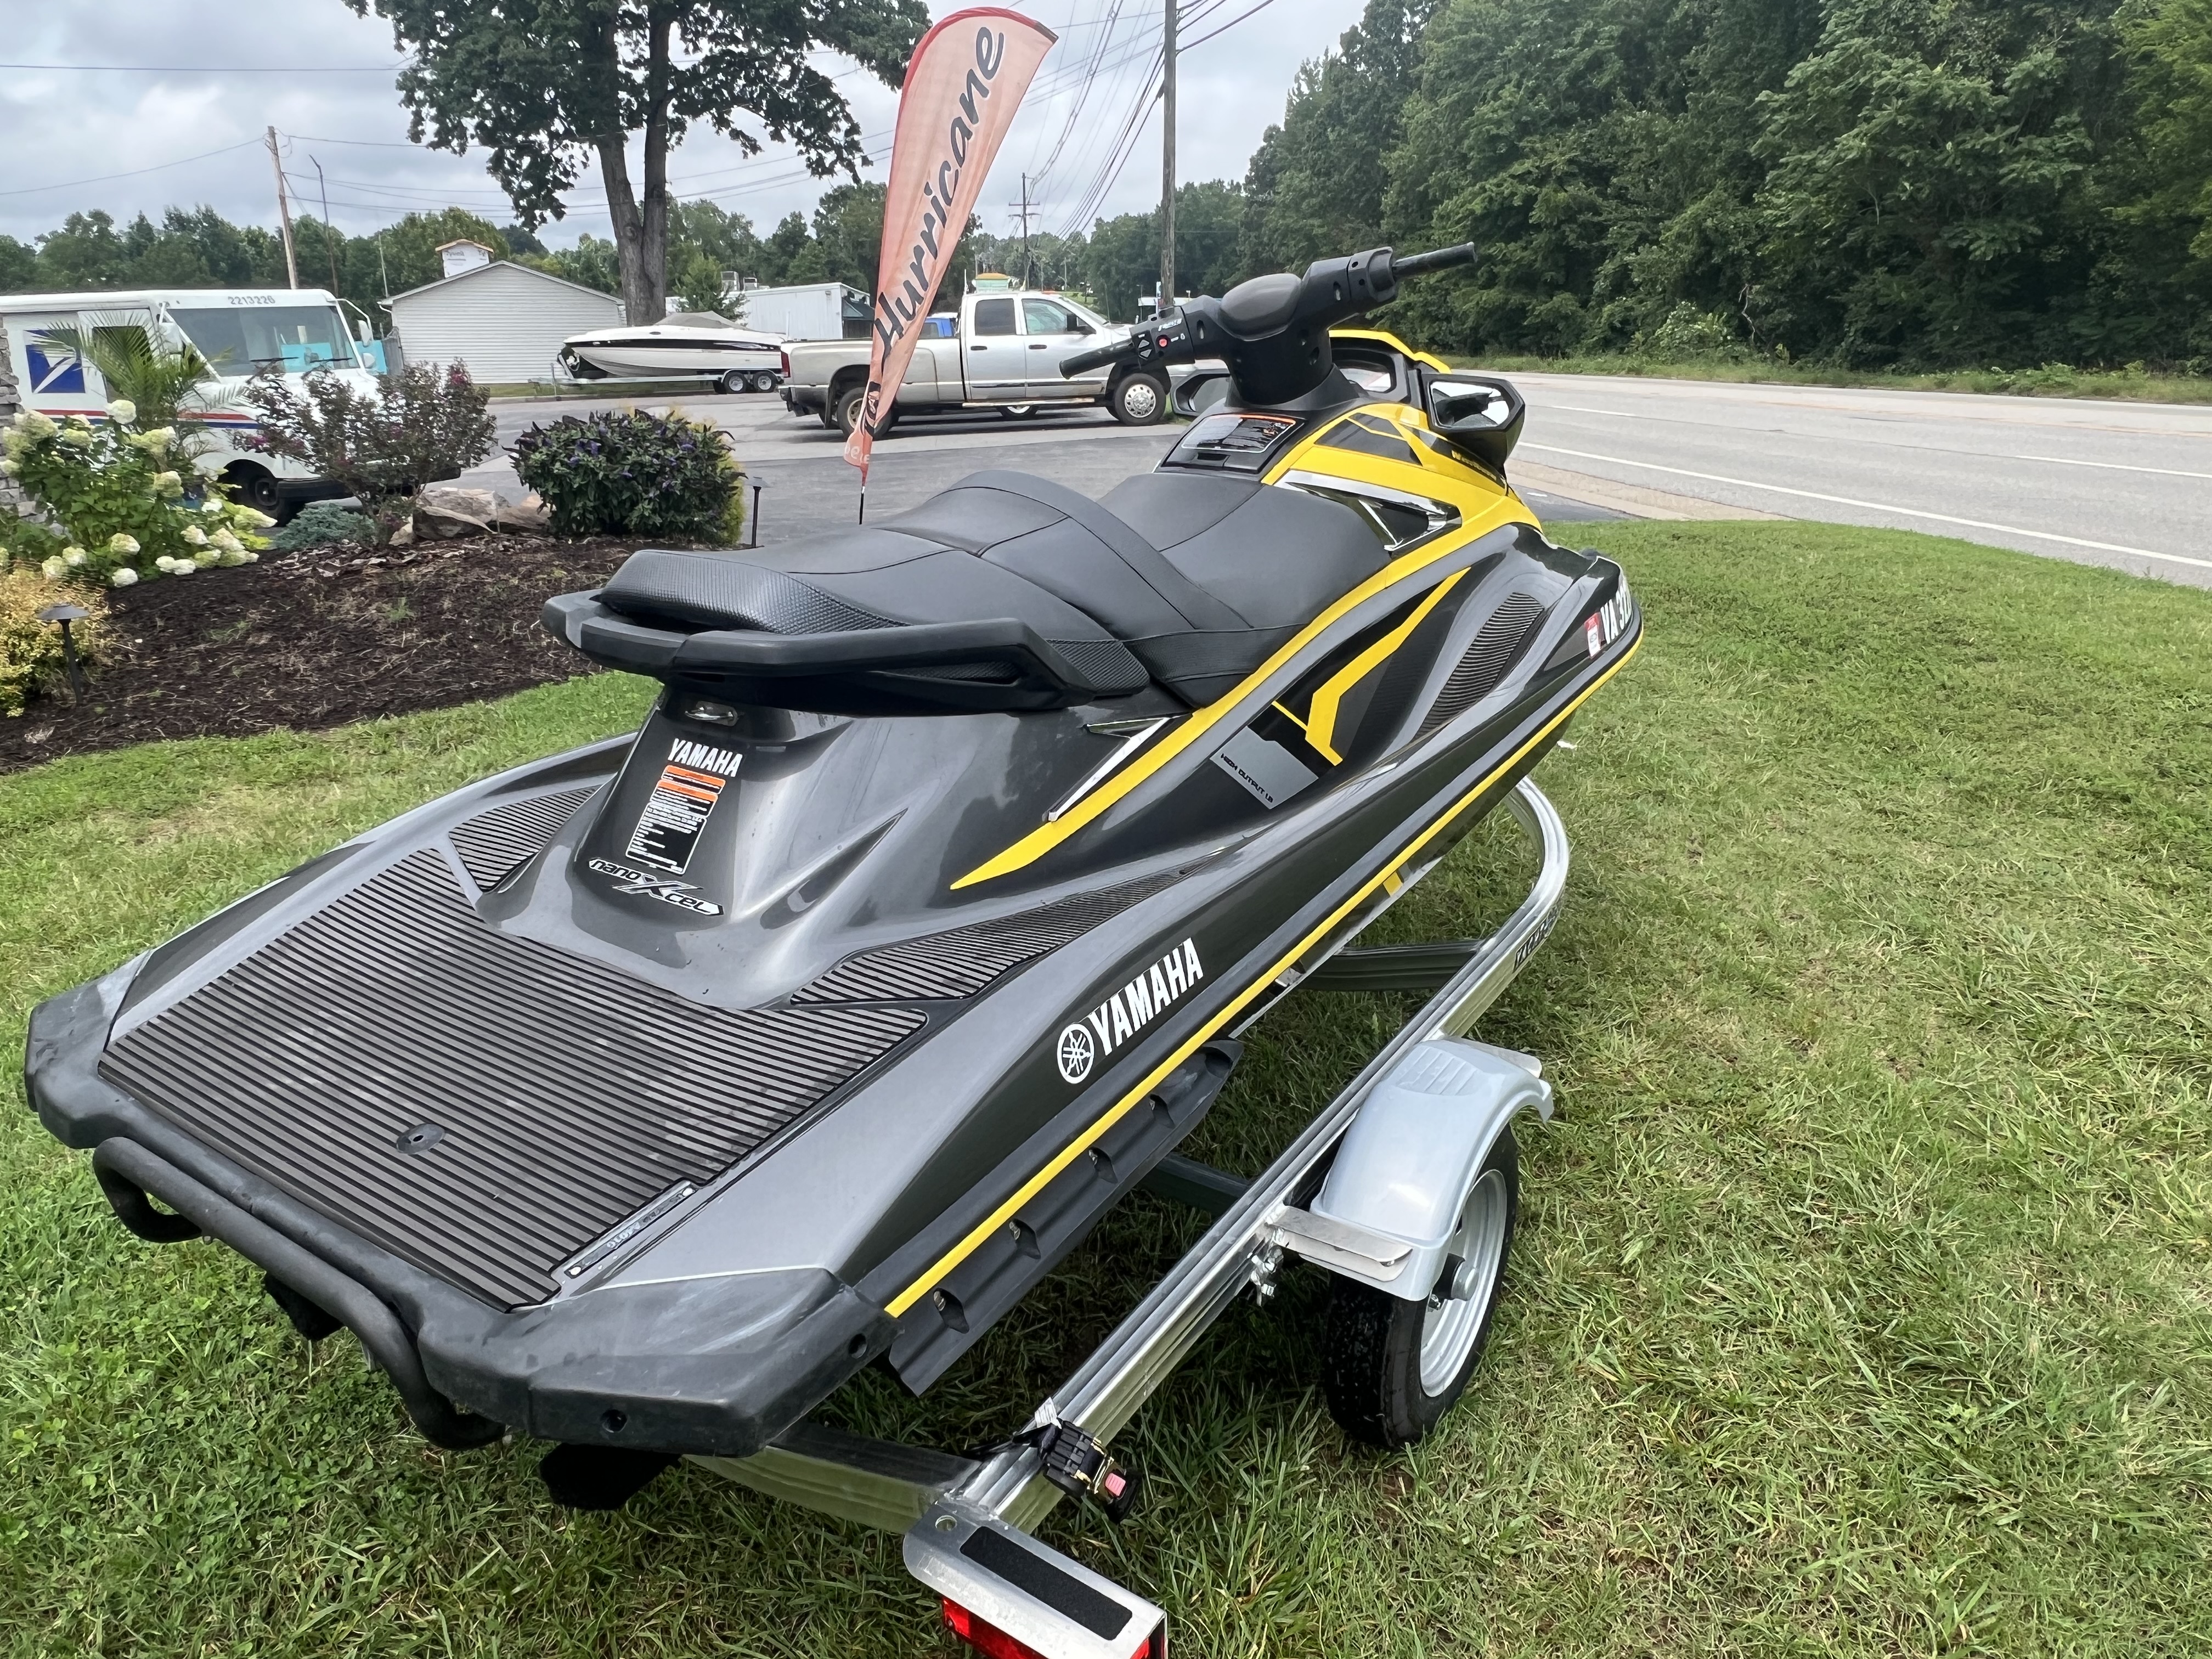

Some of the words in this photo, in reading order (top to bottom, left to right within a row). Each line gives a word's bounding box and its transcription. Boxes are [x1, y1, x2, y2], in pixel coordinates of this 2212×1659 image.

[874, 26, 1005, 374] Hurricane
[1600, 599, 1619, 644] VA
[668, 738, 743, 777] YAMAHA
[1088, 937, 1204, 1056] YAMAHA
